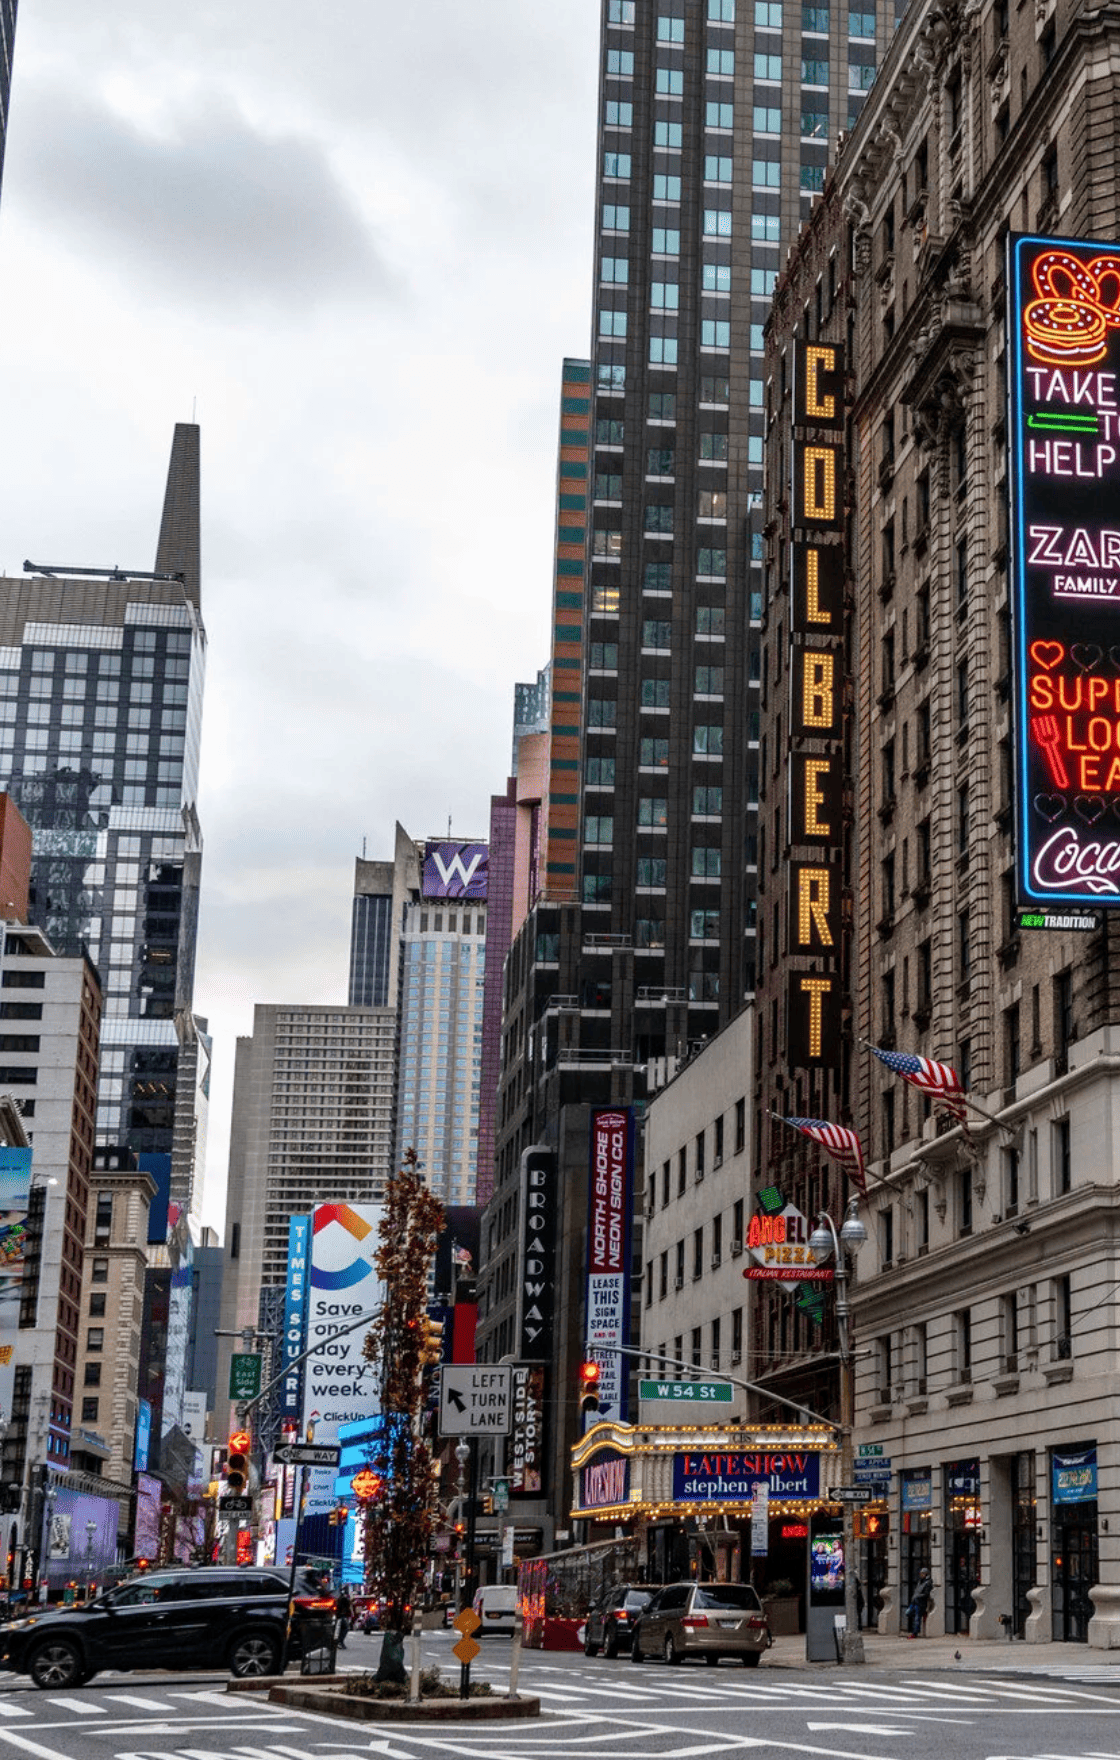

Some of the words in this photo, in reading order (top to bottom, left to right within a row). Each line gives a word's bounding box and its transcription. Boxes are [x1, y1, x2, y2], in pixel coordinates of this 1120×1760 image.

[1026, 367, 1117, 406] TAKE
[1030, 439, 1116, 477] HELP
[1054, 575, 1117, 593] FAMILY
[800, 346, 835, 1057] COLBERT
[431, 852, 483, 888] W
[612, 1131, 624, 1161] CO.
[595, 1131, 608, 1196] SHORE
[610, 1163, 623, 1209] SIGN
[594, 1199, 607, 1267] NORTH
[609, 1212, 621, 1268] NEON
[290, 1225, 306, 1302] TIMES
[524, 1170, 547, 1343] BROADWAY
[764, 1246, 818, 1264] PIZZA
[592, 1278, 620, 1289] LEASE
[593, 1290, 620, 1305] THIS
[315, 1301, 363, 1316] Save
[594, 1306, 616, 1318] SIGN
[590, 1318, 620, 1329] SPACE
[285, 1313, 301, 1407] SQUARE
[313, 1341, 351, 1360] day
[594, 1351, 617, 1359] TREET
[312, 1364, 366, 1381] every
[596, 1361, 615, 1369] EVEL
[311, 1381, 368, 1397] week.
[472, 1374, 505, 1388] LEFT
[471, 1393, 507, 1407] TURN
[515, 1370, 527, 1423] SIDE
[657, 1384, 670, 1397] W
[673, 1385, 695, 1398] 54
[700, 1386, 716, 1398] St
[323, 1412, 366, 1422] ClickUp
[470, 1412, 505, 1426] LANE
[525, 1397, 537, 1463] STORY
[313, 1452, 335, 1461] WAY
[512, 1427, 525, 1488] WEST
[683, 1454, 740, 1475] LATE
[743, 1454, 809, 1475] SHOW
[683, 1475, 748, 1499] stephen
